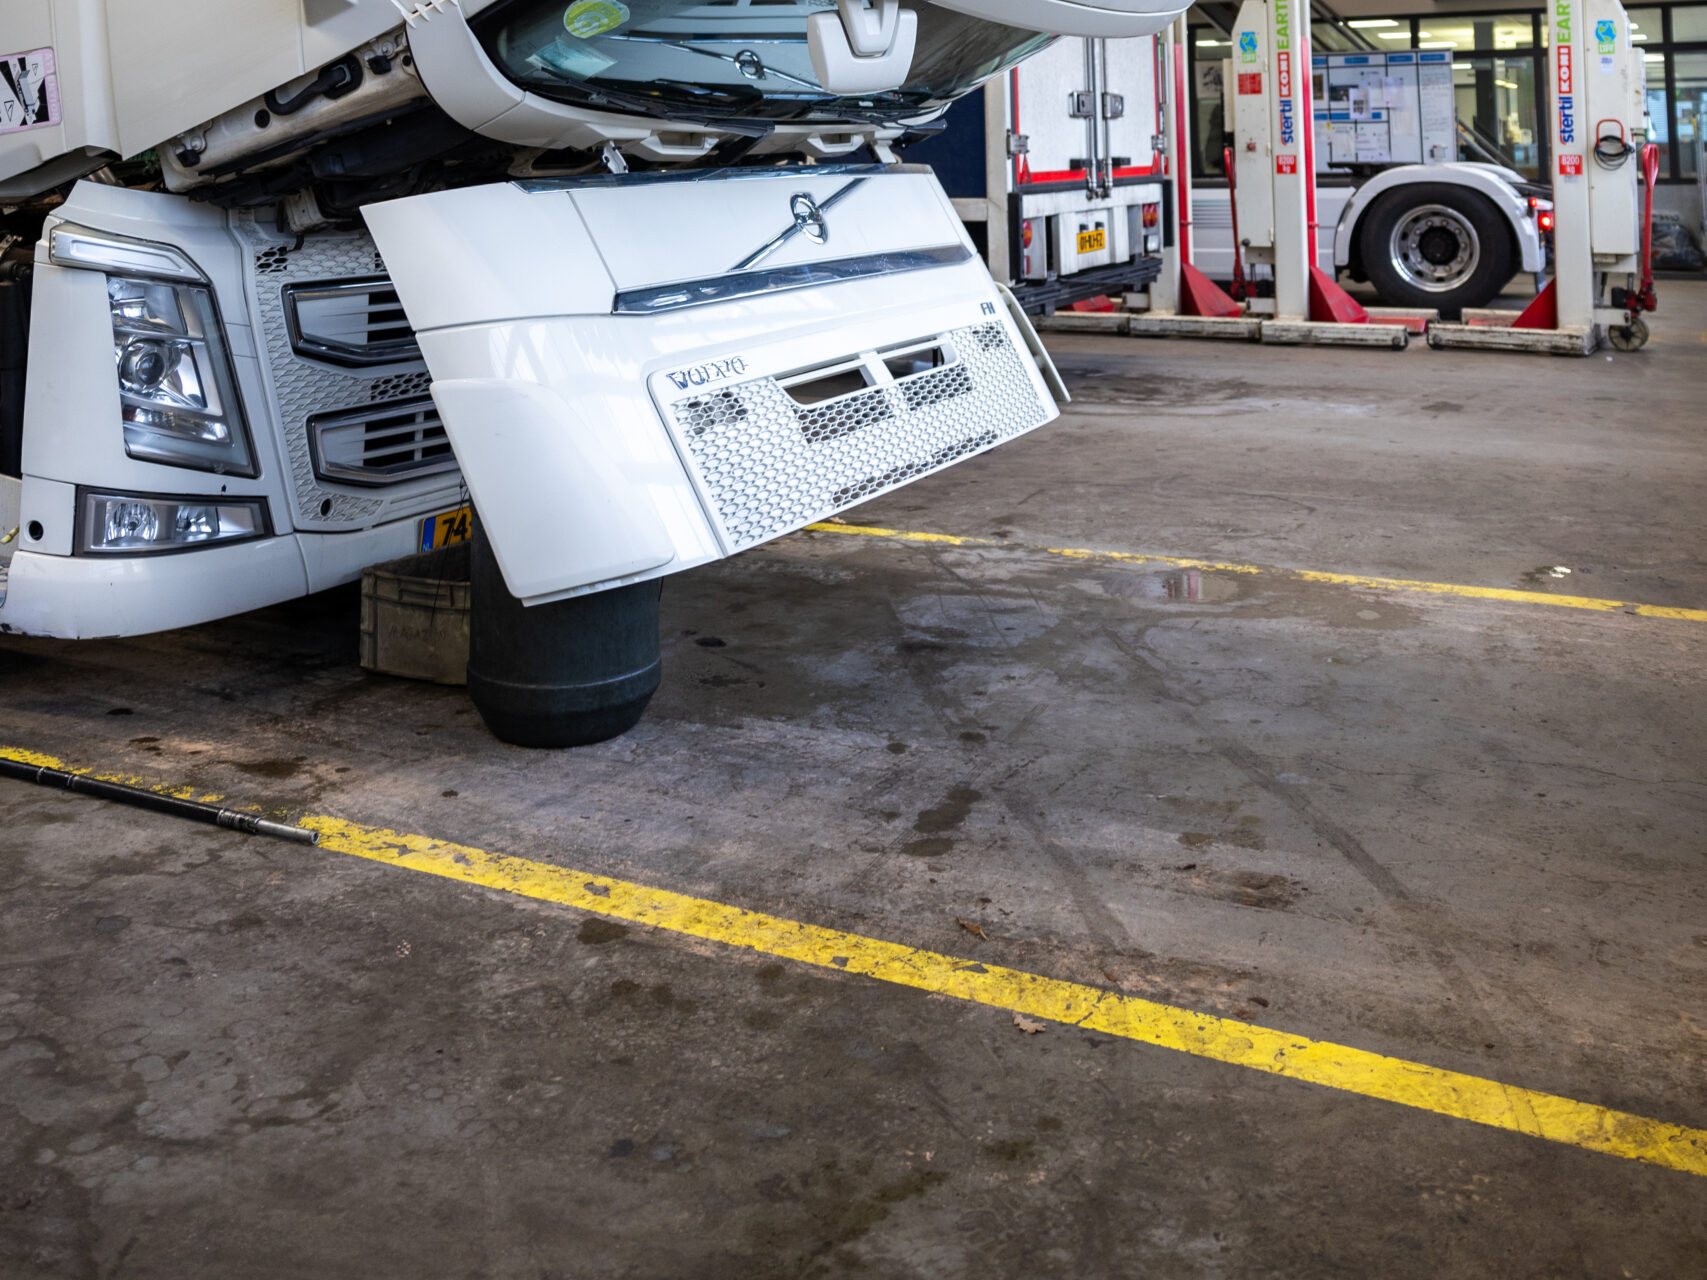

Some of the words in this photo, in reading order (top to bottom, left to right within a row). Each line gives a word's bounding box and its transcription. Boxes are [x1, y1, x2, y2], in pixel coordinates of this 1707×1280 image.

[1278, 53, 1291, 97] KONI
[1559, 47, 1571, 93] KONI
[1279, 99, 1294, 146] stertil
[1558, 96, 1574, 146] stertil
